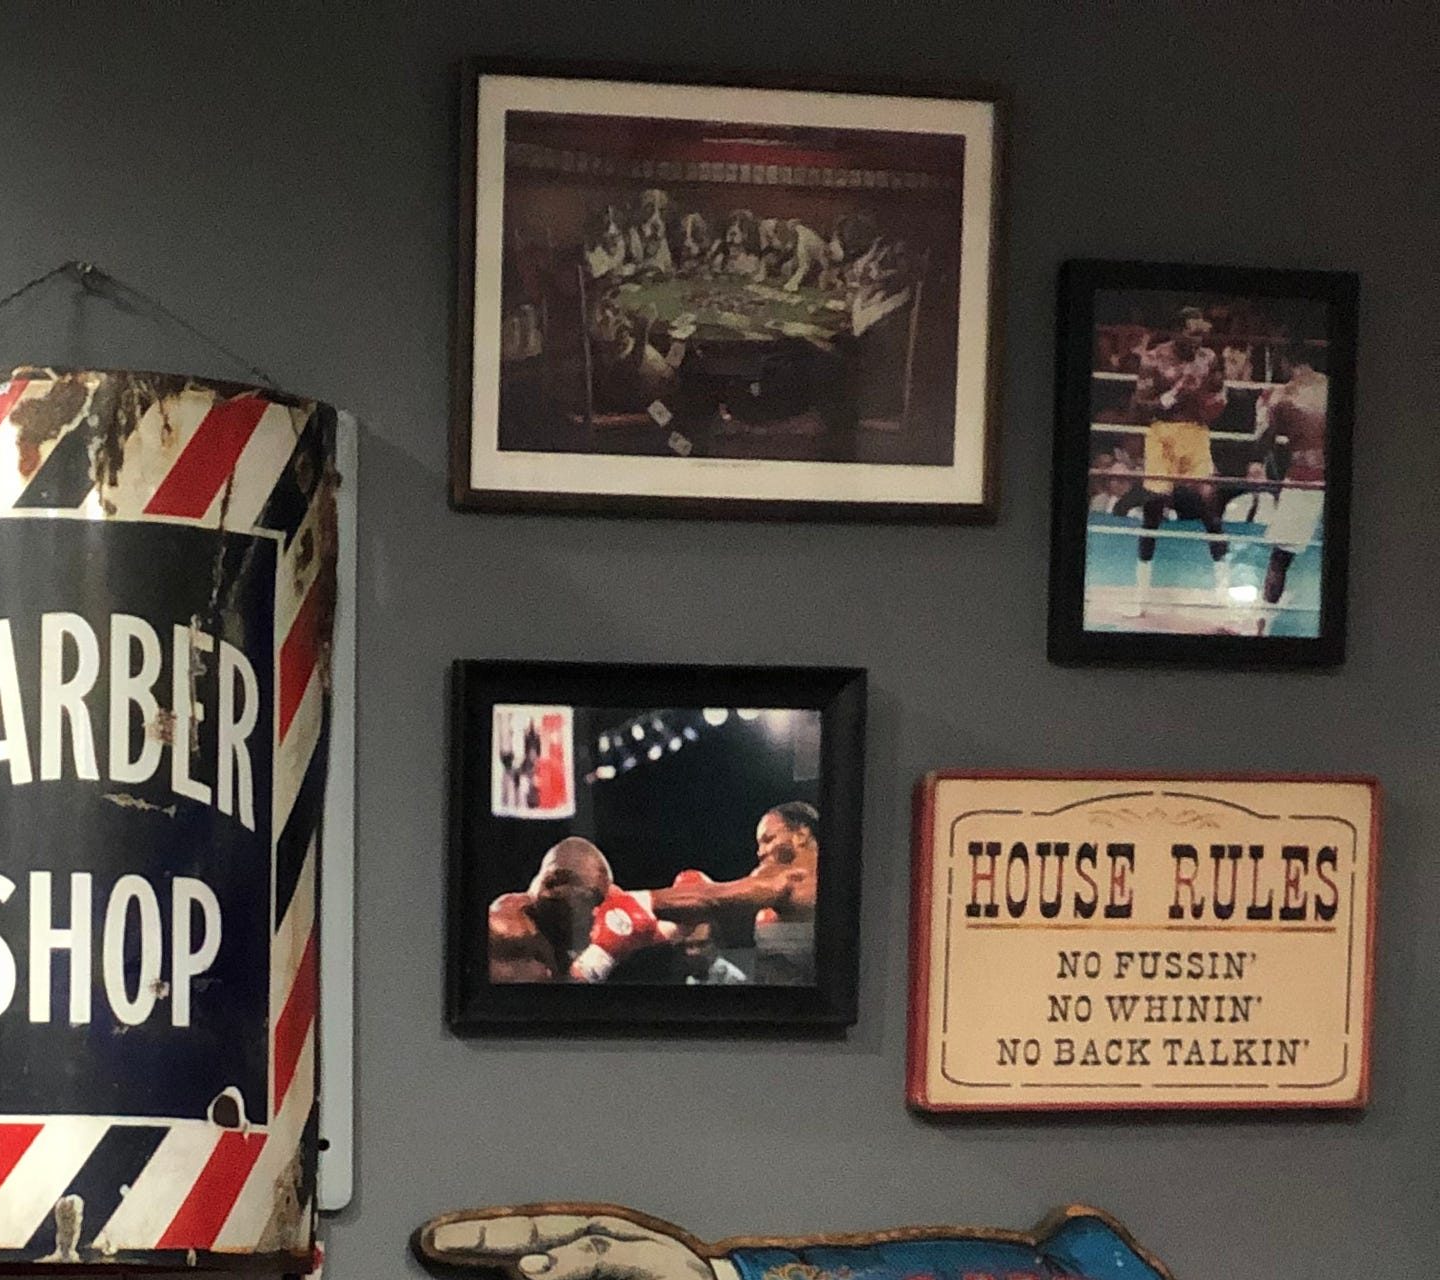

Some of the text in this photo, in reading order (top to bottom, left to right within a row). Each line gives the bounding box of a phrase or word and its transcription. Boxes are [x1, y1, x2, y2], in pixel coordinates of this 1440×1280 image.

[966, 842, 1339, 921] HOUSE RULES
[1057, 951, 1256, 979] NO FUSSIN'
[1048, 995, 1262, 1022] NO WHININ'
[997, 1038, 1310, 1066] NO BACK TALKIN'
